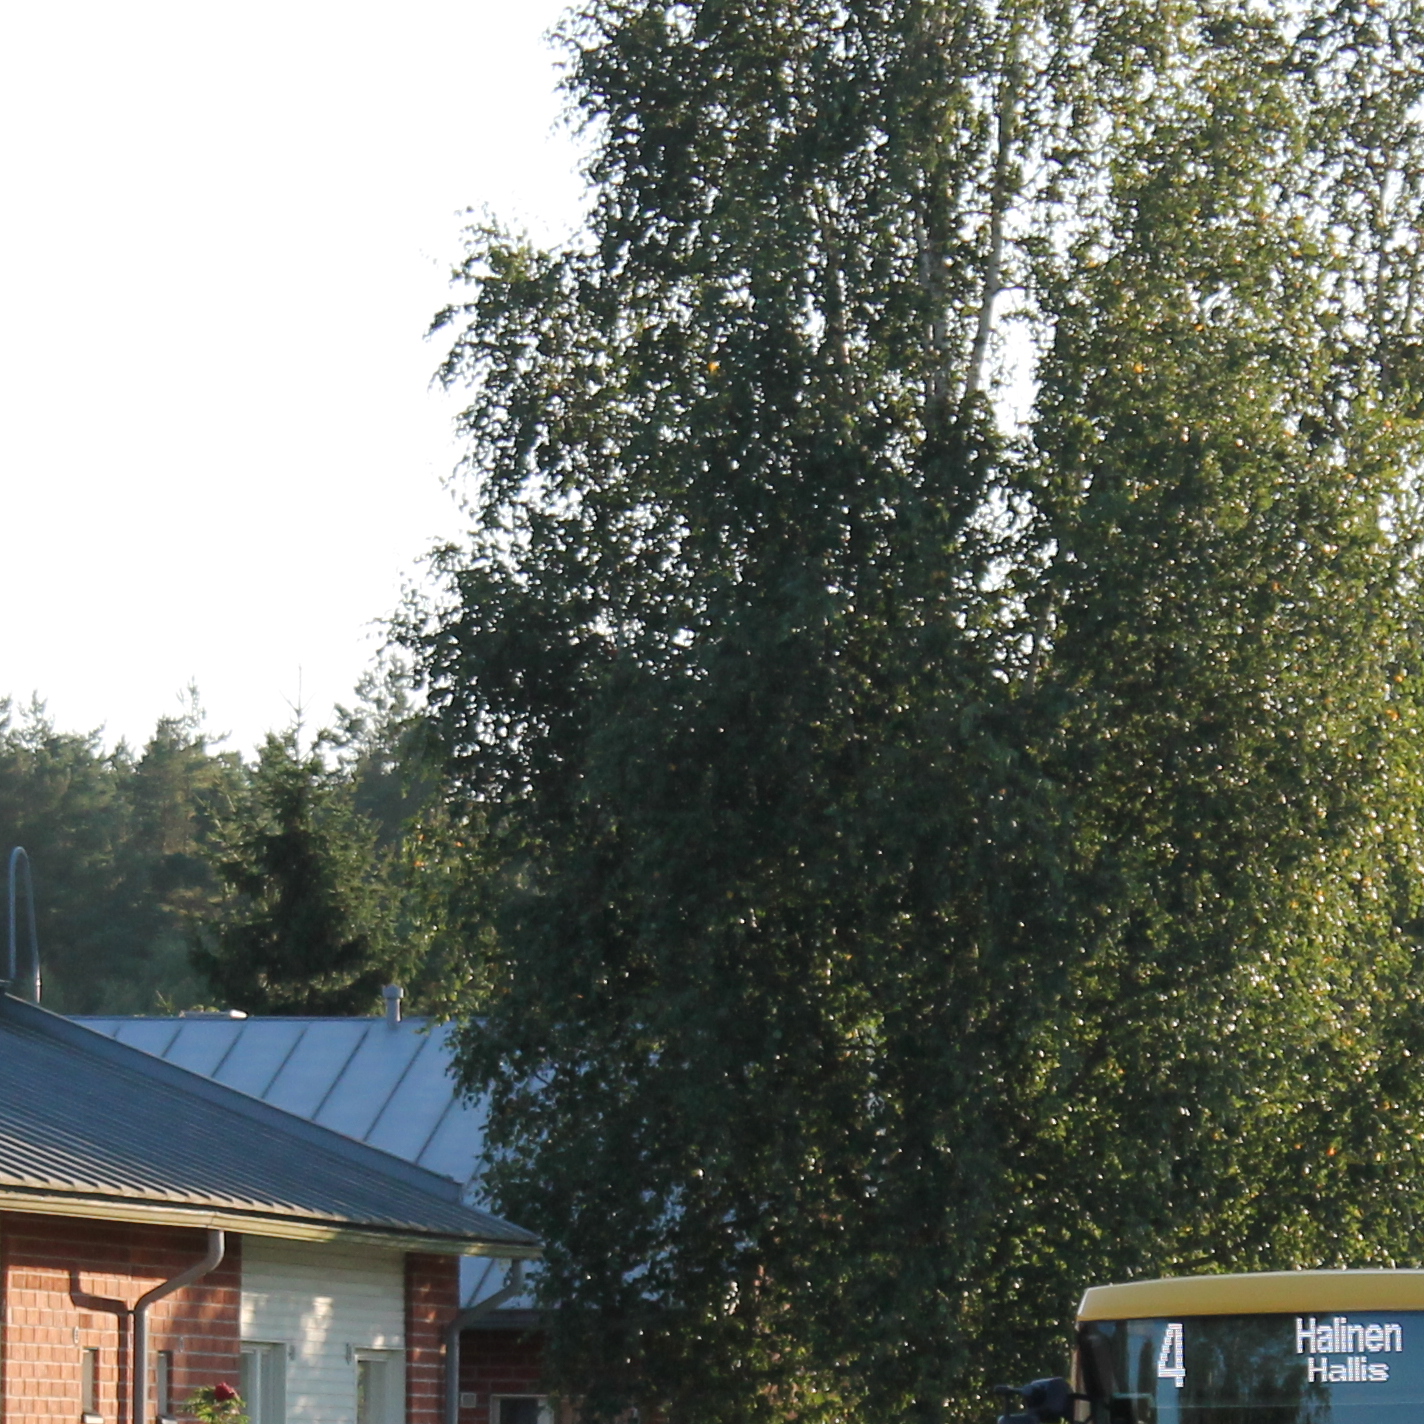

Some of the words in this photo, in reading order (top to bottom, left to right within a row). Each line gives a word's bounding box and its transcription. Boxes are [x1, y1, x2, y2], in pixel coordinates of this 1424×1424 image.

[1296, 1317, 1402, 1353] Halinen
[1157, 1323, 1186, 1387] 4
[1308, 1356, 1390, 1382] Hallis
